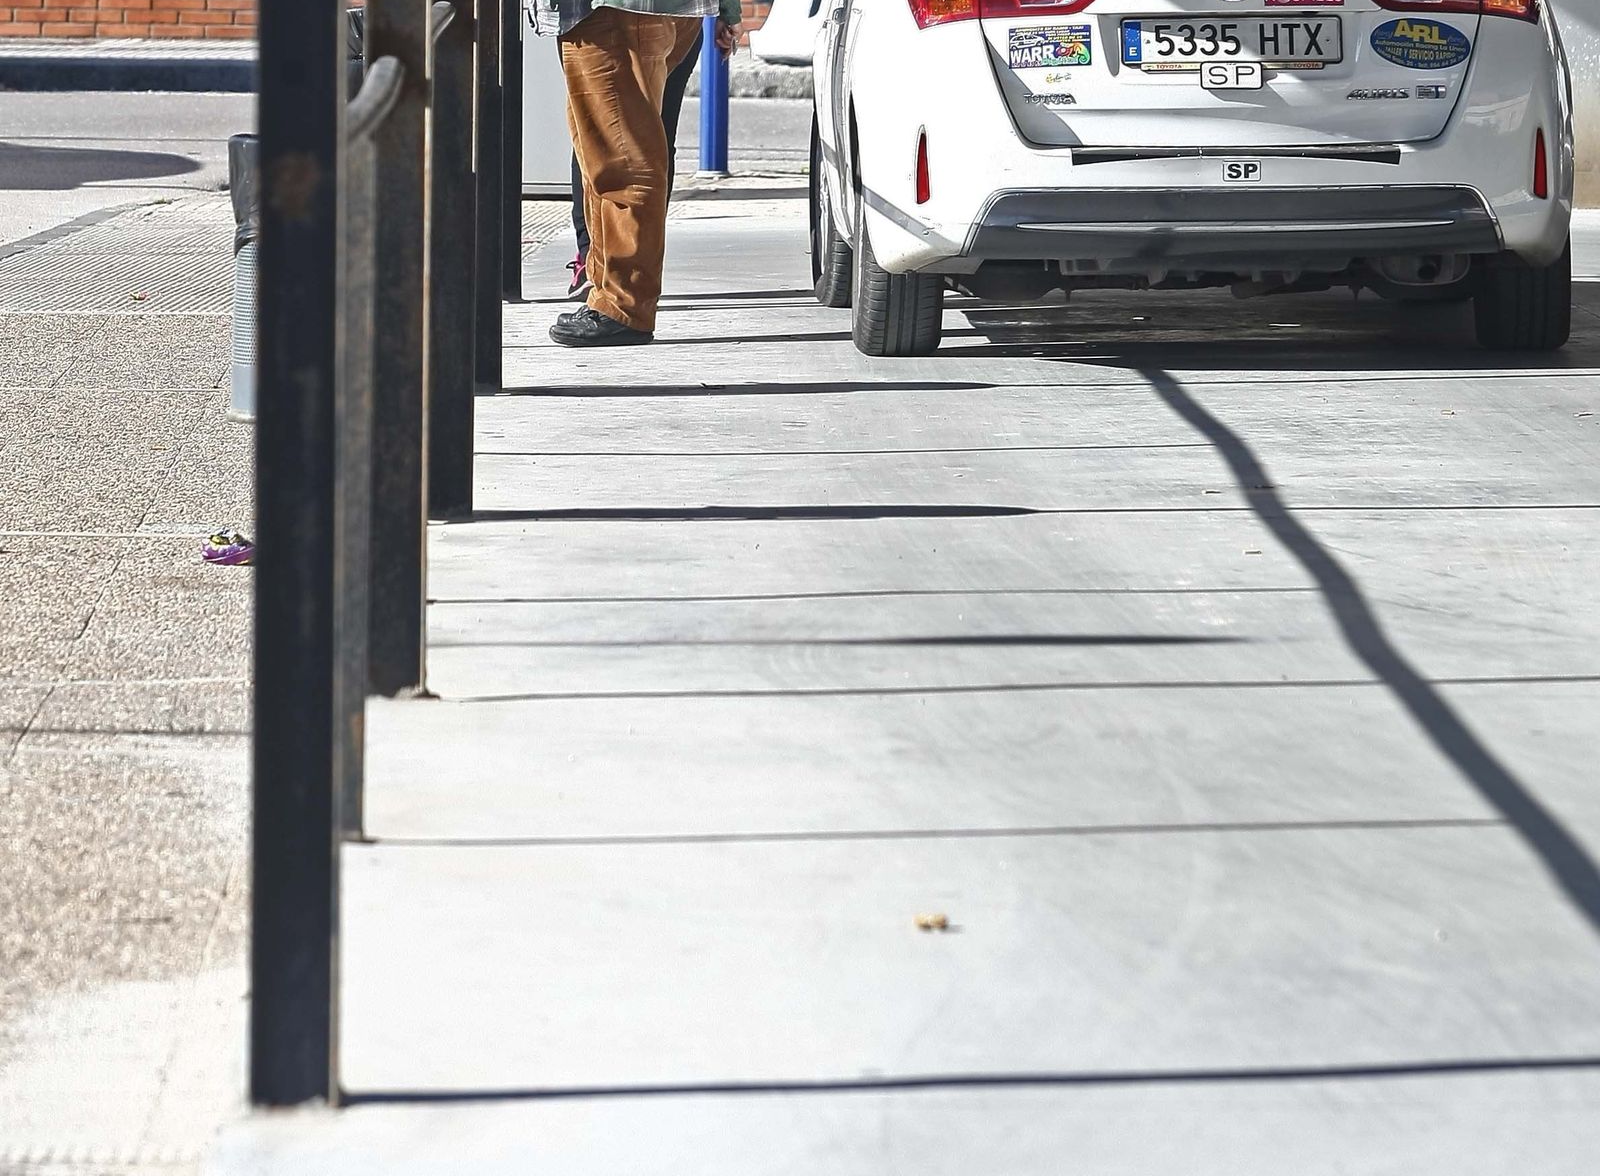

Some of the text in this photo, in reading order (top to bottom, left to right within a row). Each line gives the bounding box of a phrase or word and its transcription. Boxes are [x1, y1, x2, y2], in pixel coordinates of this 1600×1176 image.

[1154, 23, 1323, 56] 5335 HTX
[1393, 19, 1447, 44] ARL
[1129, 47, 1137, 56] E
[1208, 65, 1255, 86] SP
[1227, 163, 1258, 179] SP
